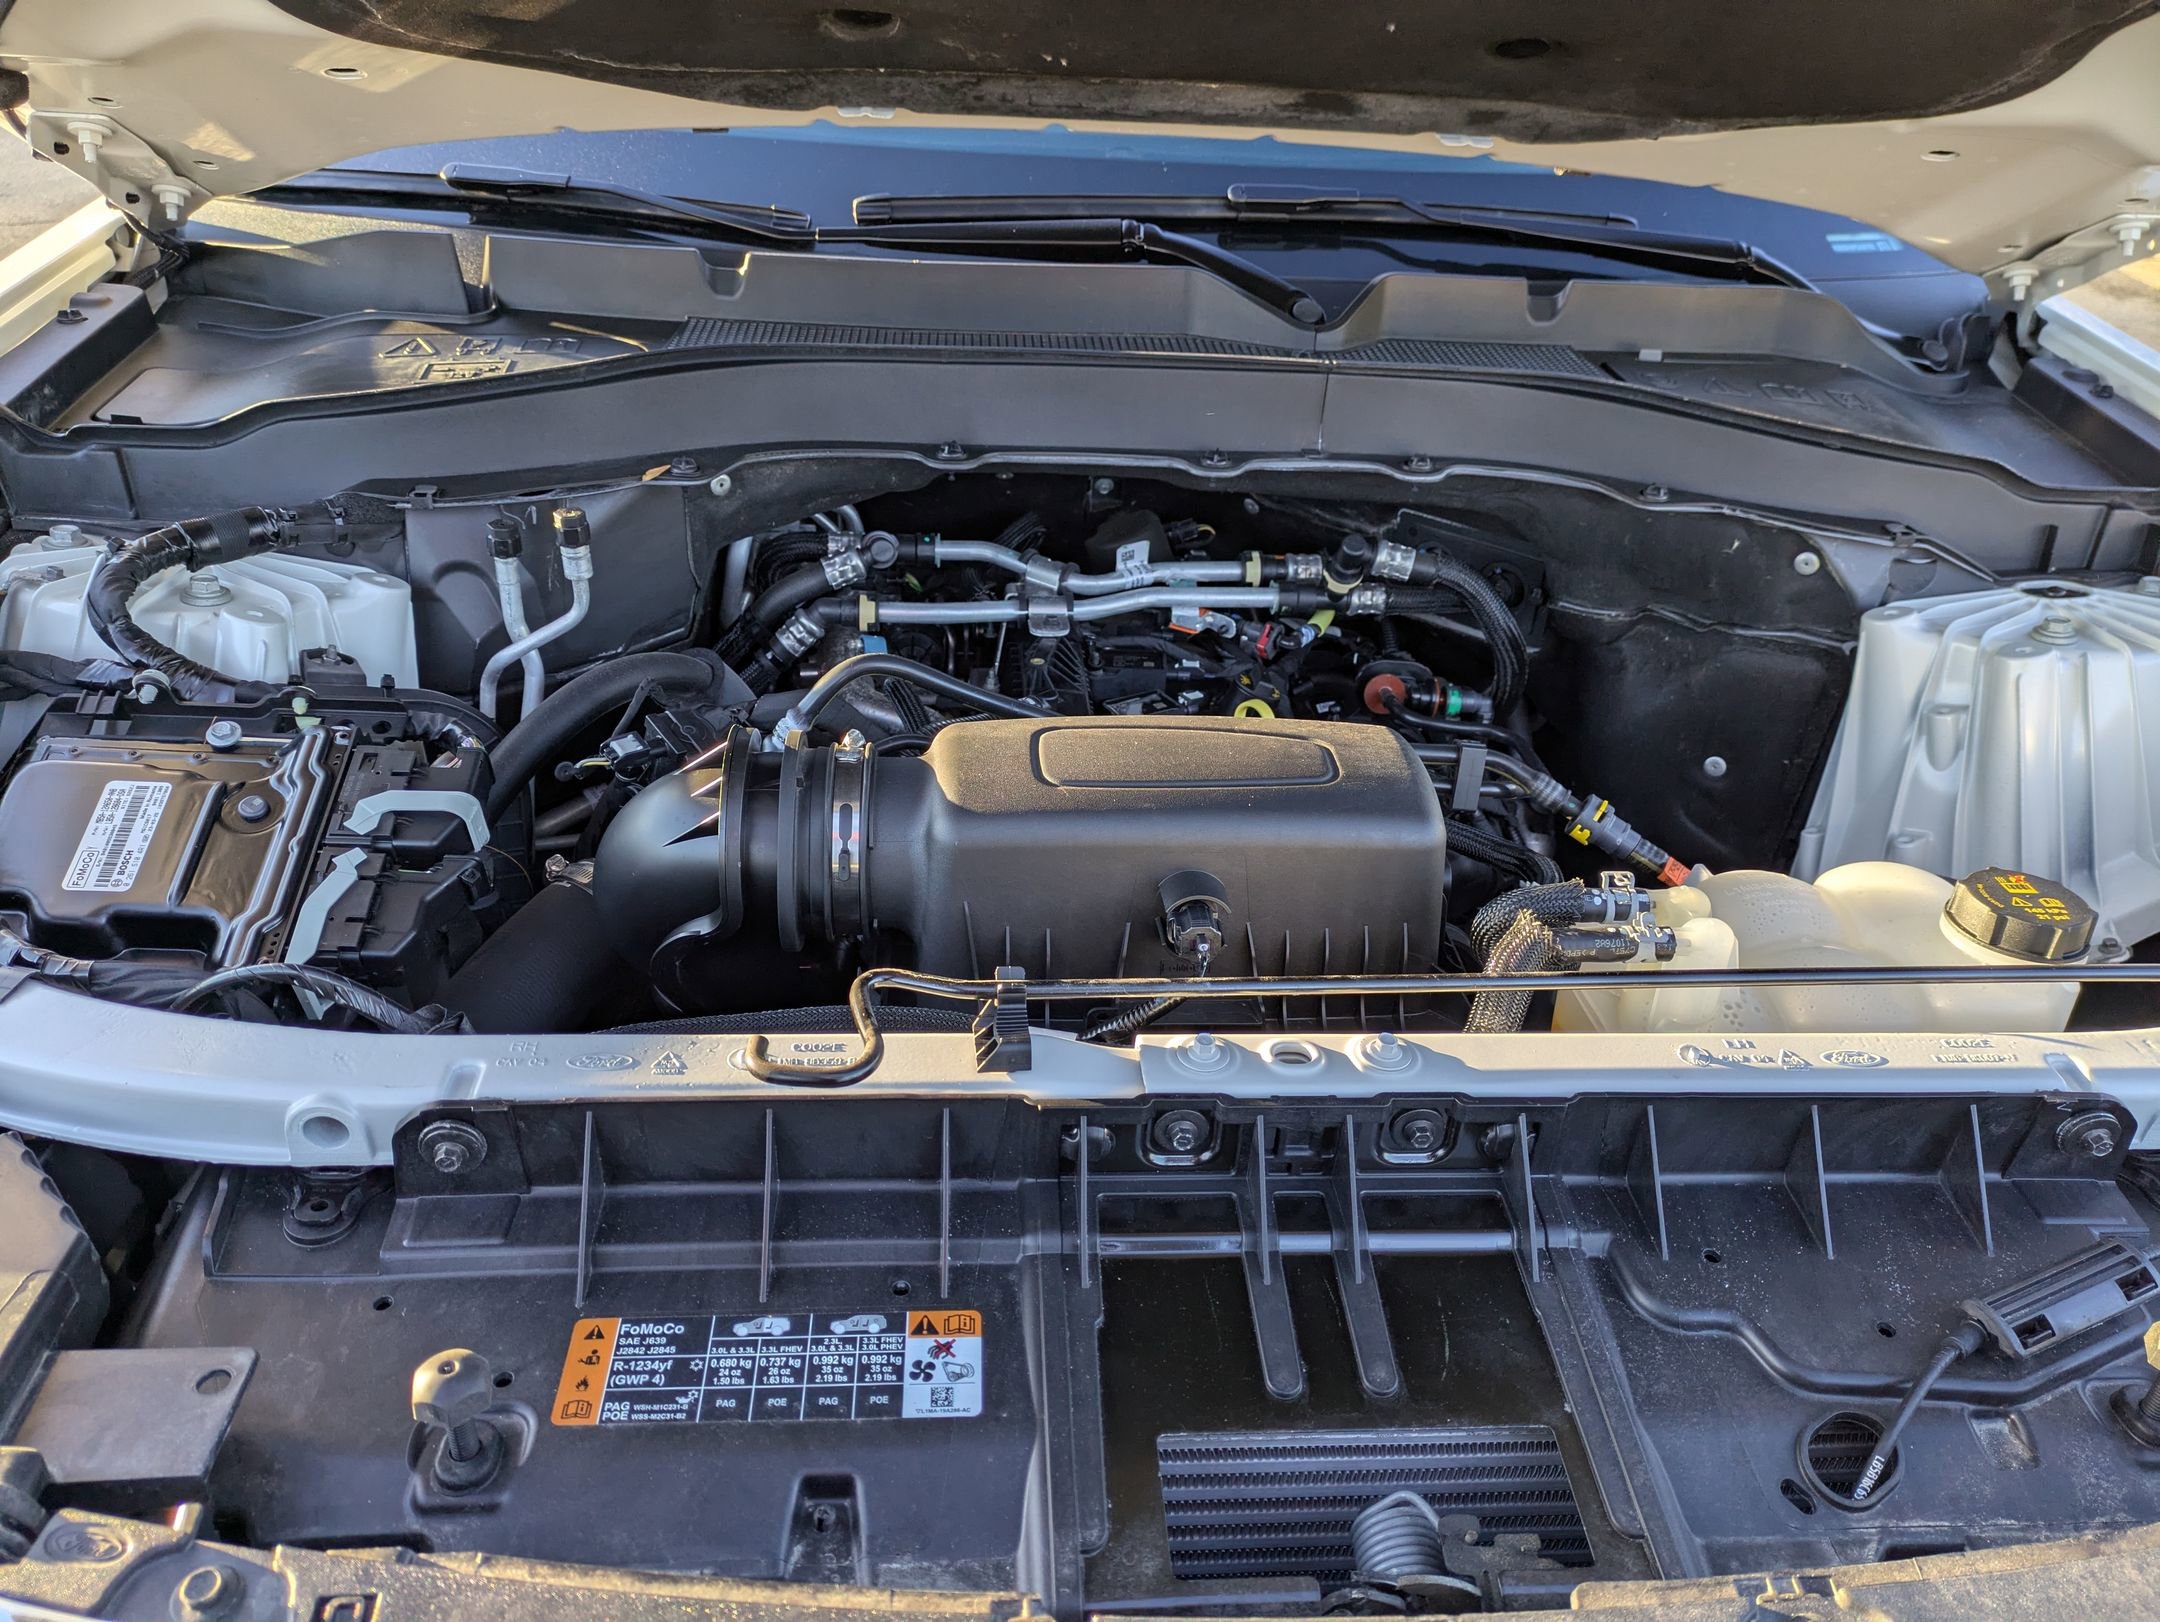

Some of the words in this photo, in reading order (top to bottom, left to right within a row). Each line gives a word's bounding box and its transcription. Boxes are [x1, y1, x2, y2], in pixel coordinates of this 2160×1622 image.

[117, 849, 134, 876] BOSCH
[72, 852, 96, 887] FoMoCo
[576, 1054, 623, 1069] Ford
[1831, 1051, 1873, 1065] Ford
[620, 1323, 685, 1336] FoMoCo
[618, 1338, 640, 1346] SAE
[642, 1337, 667, 1345] J639
[880, 1336, 904, 1344] FHEV
[616, 1346, 646, 1355] J2842
[646, 1346, 676, 1354] J2845
[738, 1346, 756, 1354] 3.3L
[761, 1346, 778, 1354] 3.3L
[780, 1345, 803, 1353] FHEV
[830, 1344, 837, 1352] &
[838, 1344, 855, 1352] 3.3L
[710, 1358, 738, 1368] 0.680
[739, 1358, 752, 1369] kg
[760, 1358, 786, 1366] 0.737
[788, 1357, 802, 1368] kg
[812, 1356, 840, 1365] 0.992
[841, 1356, 854, 1366] kg
[862, 1355, 888, 1364] 0.992
[890, 1355, 902, 1366] kg
[613, 1360, 673, 1372] R-1234yf
[610, 1375, 650, 1387] (GWP
[652, 1374, 665, 1386] 4)
[731, 1377, 745, 1385] lbs
[762, 1376, 780, 1384] 1.63
[781, 1376, 794, 1384] lbs
[816, 1374, 833, 1382] 2.19
[834, 1374, 848, 1382] lbs
[864, 1374, 882, 1382] 2.19
[884, 1373, 897, 1382] lbs
[715, 1399, 736, 1408] PAG
[768, 1398, 788, 1406] POE
[818, 1397, 839, 1406] PAG
[870, 1396, 889, 1404] POE
[604, 1402, 630, 1412] PAG
[602, 1411, 628, 1421] POE
[1853, 1455, 1885, 1501] LB5B16C65
